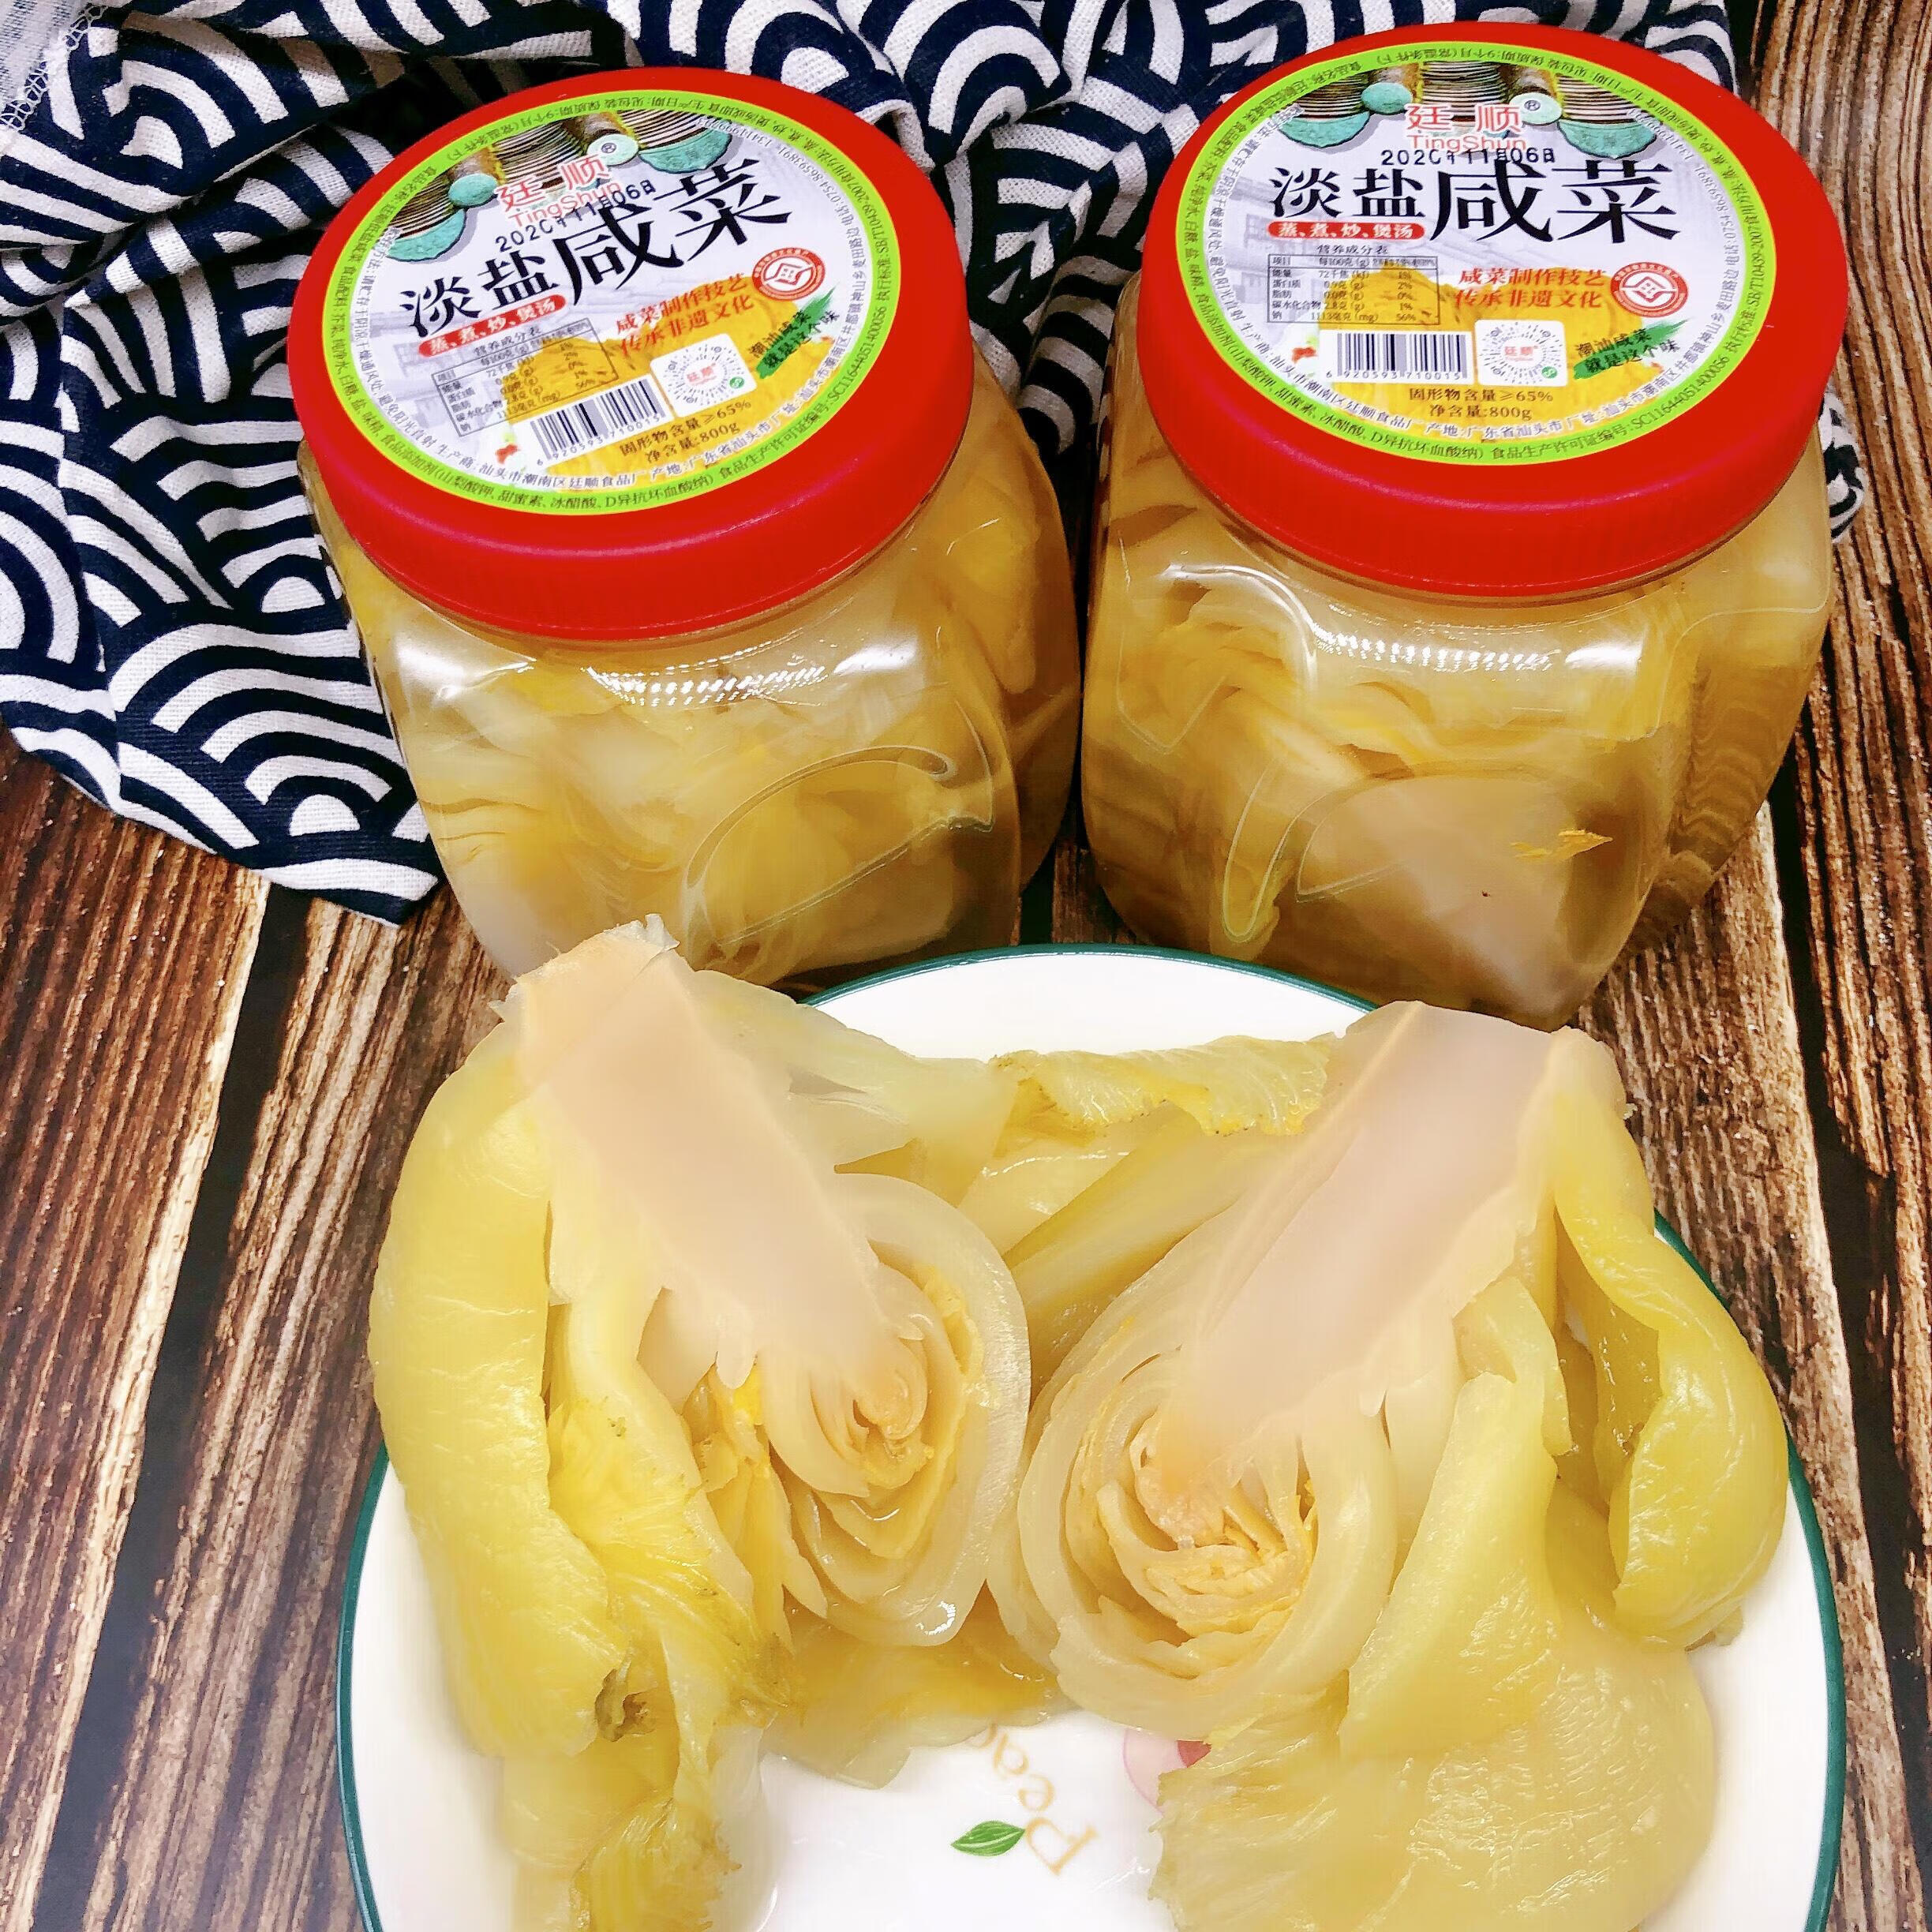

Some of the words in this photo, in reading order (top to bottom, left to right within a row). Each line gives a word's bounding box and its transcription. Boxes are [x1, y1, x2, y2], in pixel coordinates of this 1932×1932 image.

[1407, 105, 1522, 132] 廷顺
[1408, 135, 1526, 152] TingShun
[496, 155, 609, 212] 廷顺
[508, 182, 622, 227] TingShun
[1269, 159, 1680, 243] 淡盐咸菜
[400, 159, 792, 339] 淡盐咸菜
[1456, 290, 1603, 308] 传承非遗文化
[1459, 268, 1605, 286] 咸菜制作技艺
[617, 273, 747, 333] 咸菜制作技艺
[622, 294, 754, 357] 传承非遗文化
